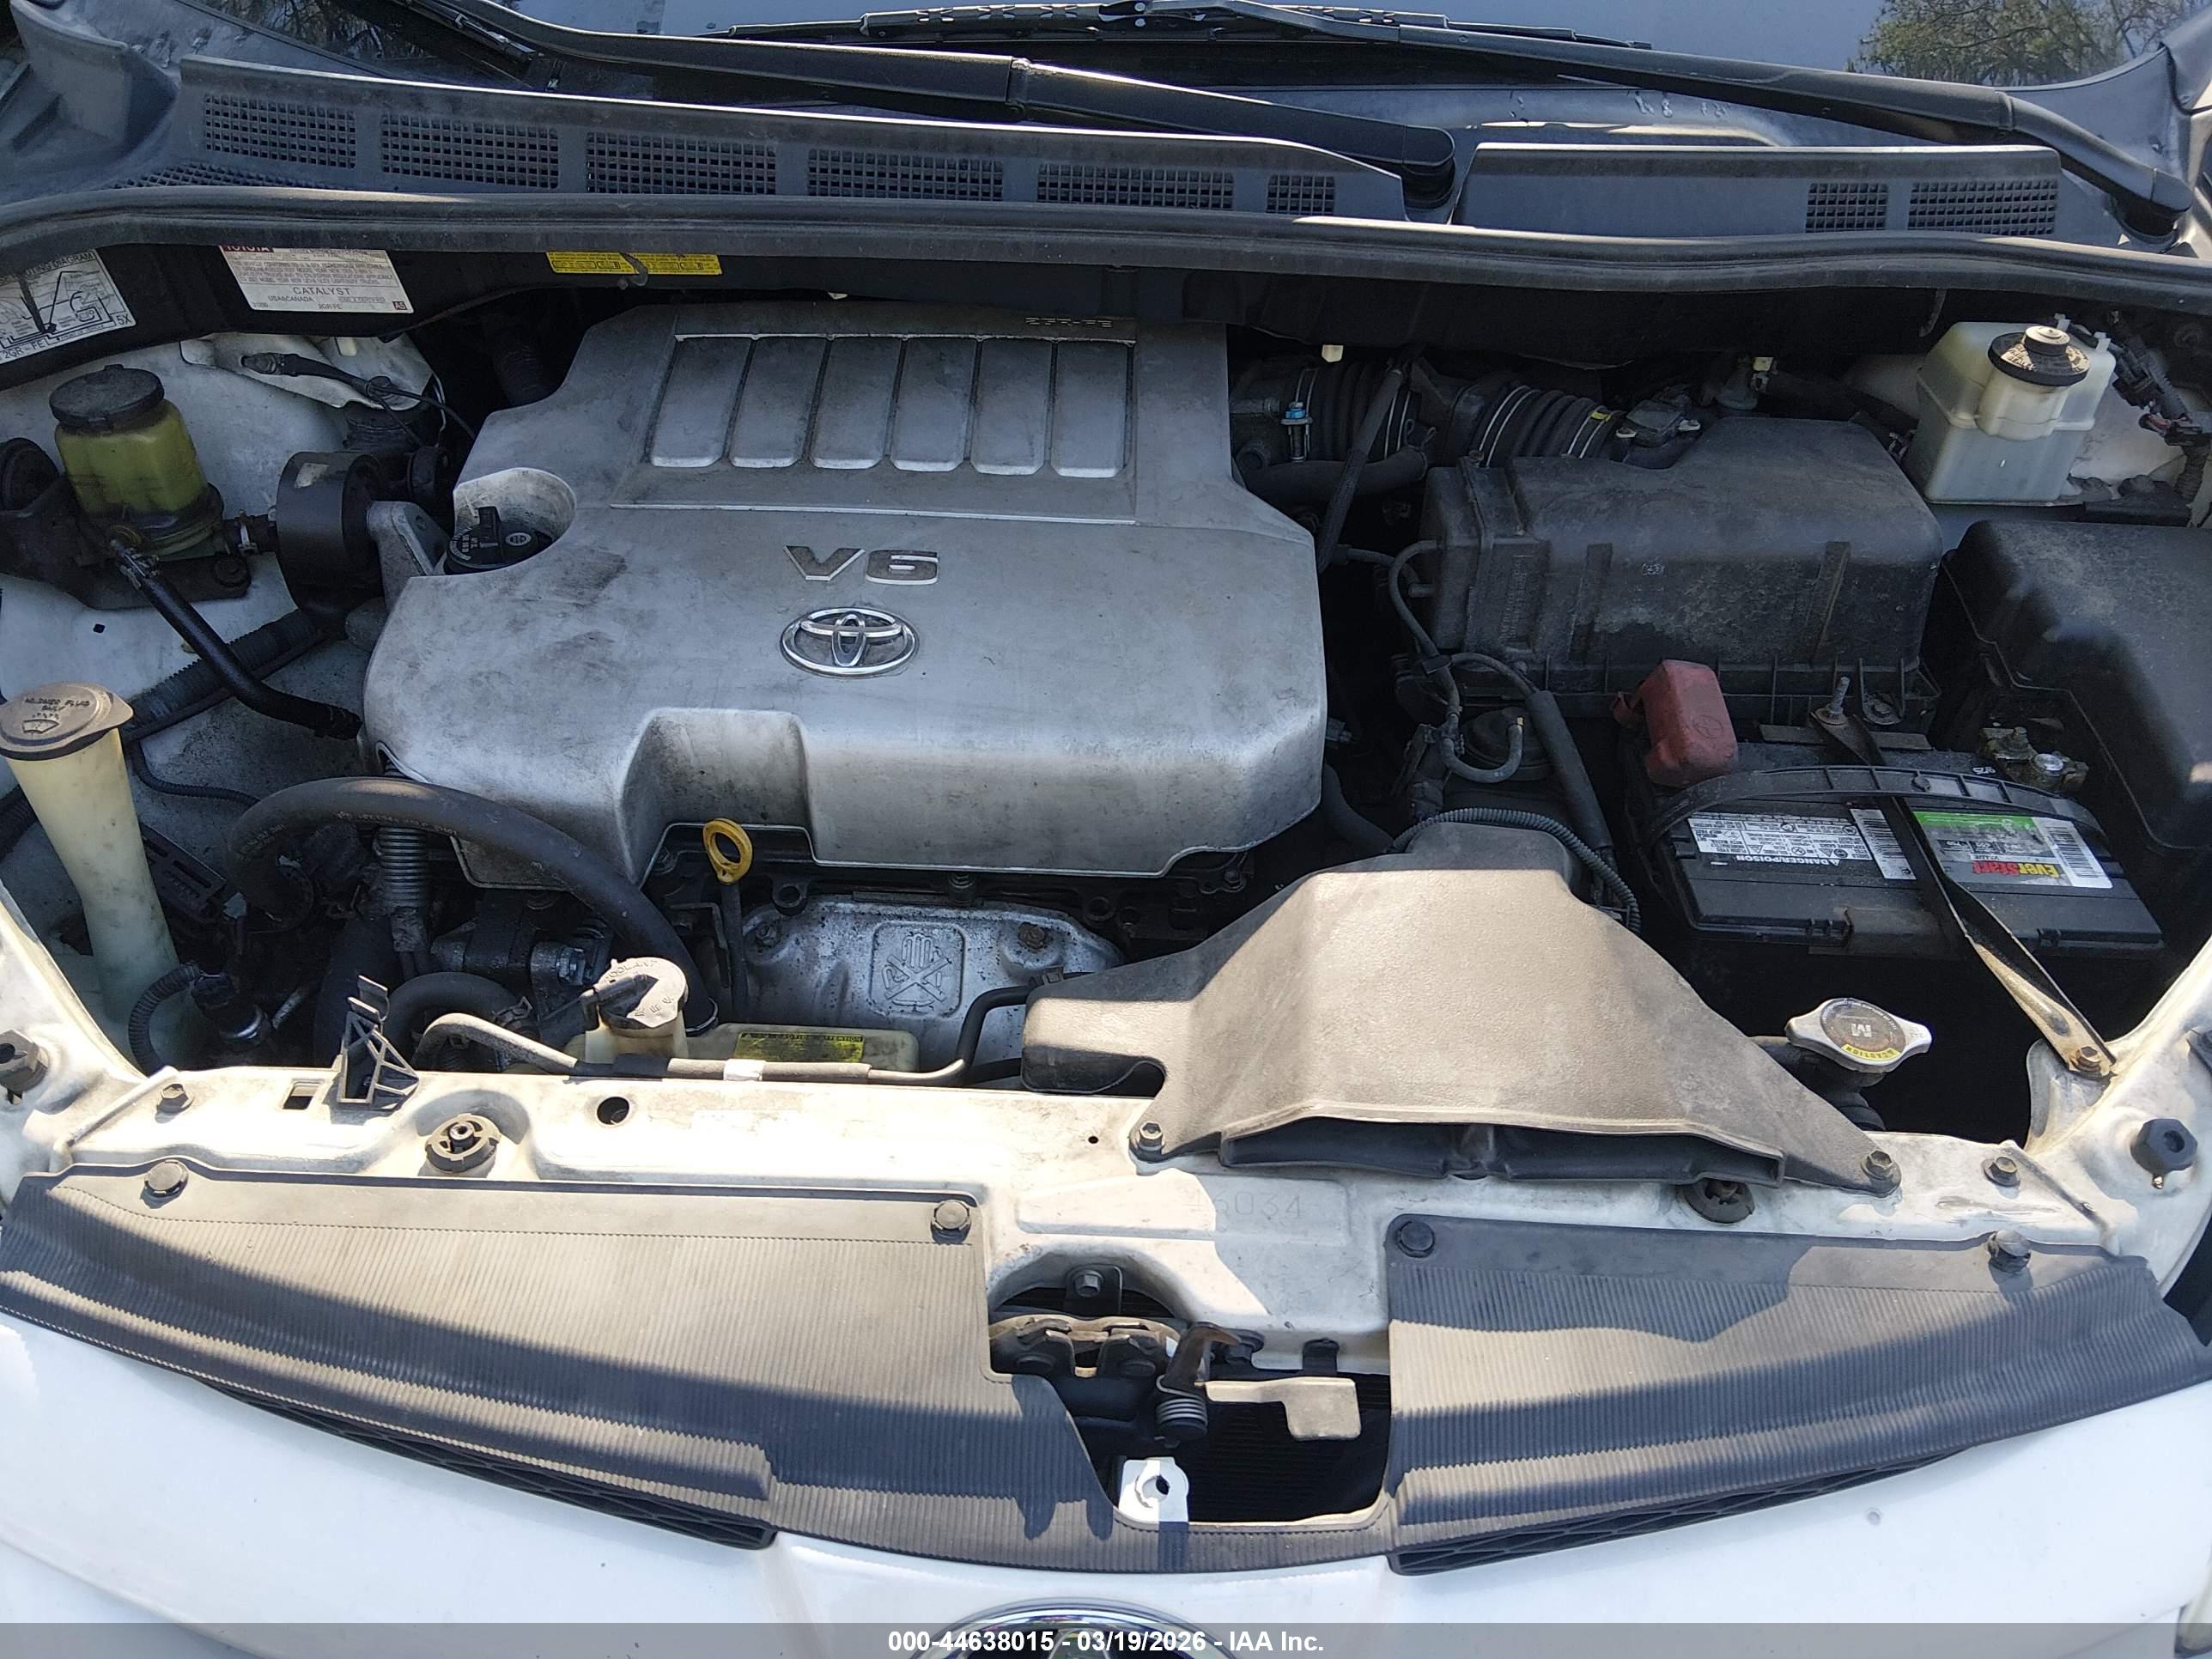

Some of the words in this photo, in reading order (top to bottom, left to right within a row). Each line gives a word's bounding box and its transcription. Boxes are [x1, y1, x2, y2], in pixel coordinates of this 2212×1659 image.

[293, 286, 352, 295] CATALYST
[394, 301, 407, 310] A5
[116, 313, 132, 325] 5X
[783, 545, 939, 586] V6
[1736, 854, 1829, 866] DANGER/POISON
[1972, 860, 2059, 878] EverStart
